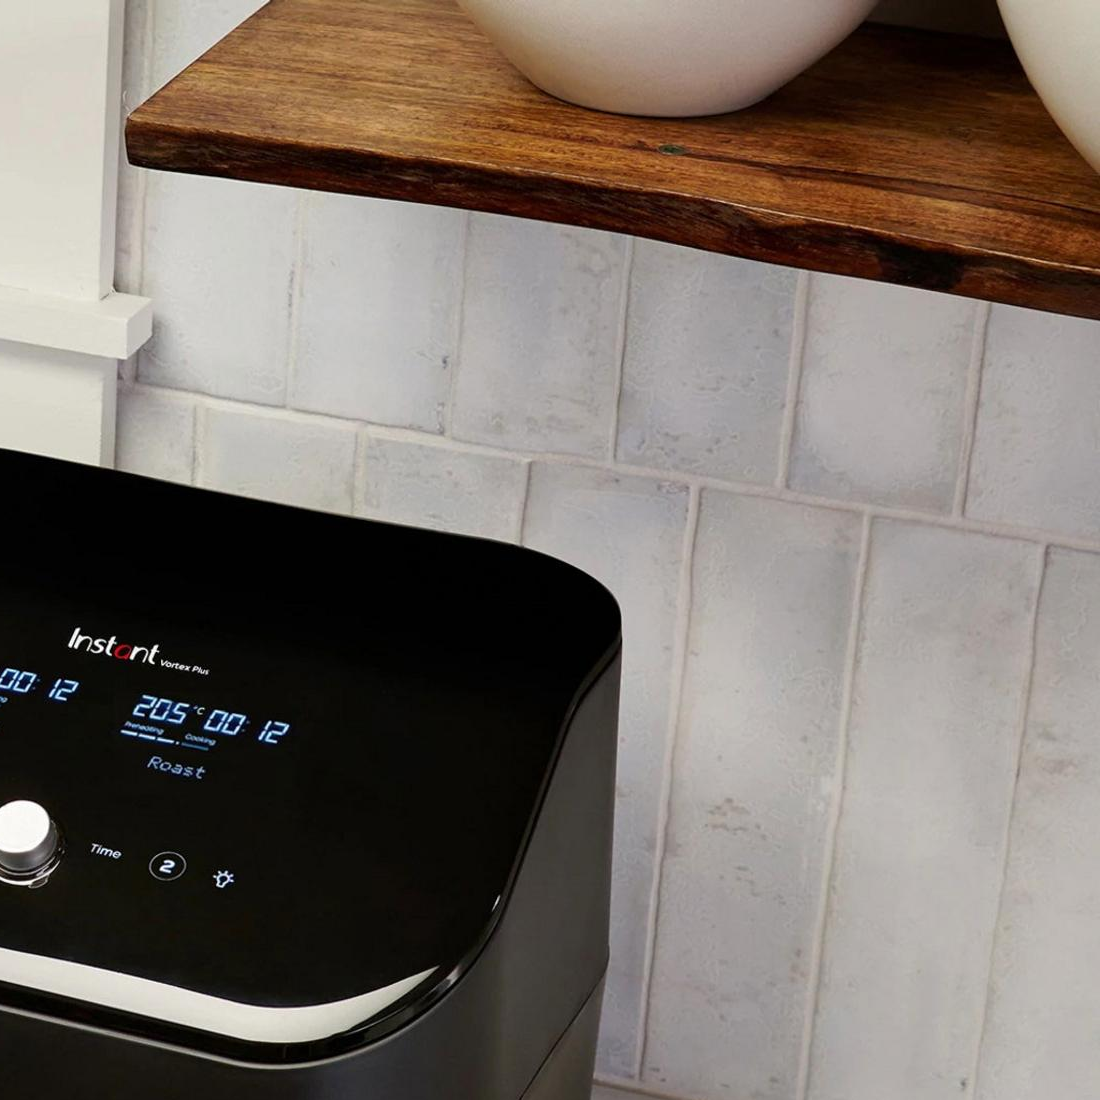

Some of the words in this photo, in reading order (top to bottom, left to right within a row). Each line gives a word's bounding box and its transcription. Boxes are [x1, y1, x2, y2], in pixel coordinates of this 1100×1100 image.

[68, 627, 160, 665] Instant
[160, 659, 191, 672] Vortex
[192, 664, 210, 676] Plus
[124, 720, 165, 735] Preheating
[184, 732, 217, 747] Cooking
[147, 755, 207, 780] Roast
[90, 842, 122, 860] Time
[159, 859, 176, 874] 2
